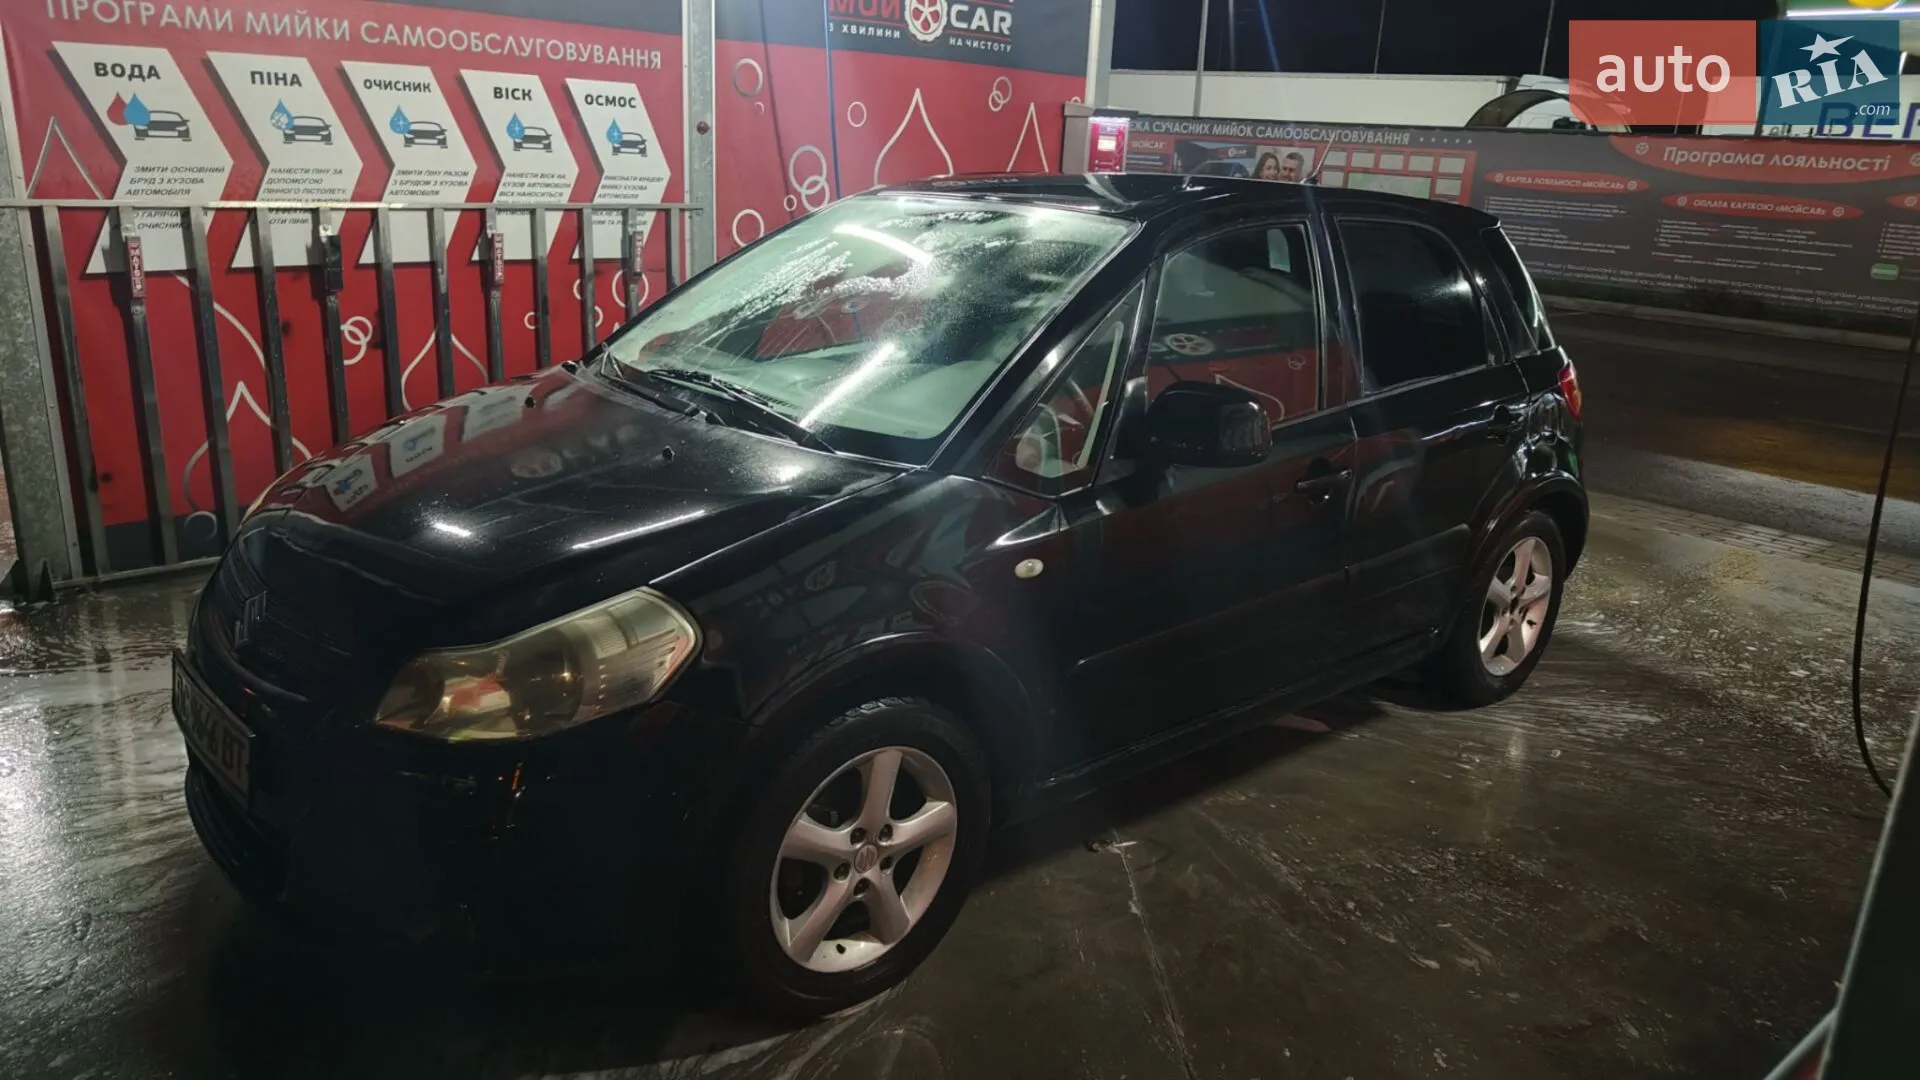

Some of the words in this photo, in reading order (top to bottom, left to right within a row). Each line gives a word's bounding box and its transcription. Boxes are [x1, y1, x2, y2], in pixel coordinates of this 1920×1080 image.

[949, 3, 1013, 36] CAR
[46, 0, 234, 33] ПРОГРАМИ
[245, 9, 351, 42] МИЙКИ
[360, 20, 662, 70] САМООБСЛУГОВУВАННЯ
[841, 24, 901, 40] ХВИЛИНИ
[949, 36, 963, 47] НА
[965, 38, 1013, 53] ЧИСТОТУ
[93, 61, 161, 82] ВОДА
[250, 70, 303, 88] ПІНА
[363, 78, 432, 94] ОЧИСНИК
[493, 86, 533, 102] ВІСК
[584, 93, 637, 109] ОСМОС
[1152, 120, 1211, 136] СУЧАСНИХ
[1211, 121, 1254, 138] МИЙОК
[1255, 125, 1410, 146] САМООБСЛУГОВУВАННЯ
[1662, 147, 1766, 169] Програма
[1769, 153, 1890, 173] лояльності
[129, 177, 157, 186] БРУД
[166, 177, 205, 185] КУЗОВА
[125, 188, 192, 196] АВТОМОБІЛЯ
